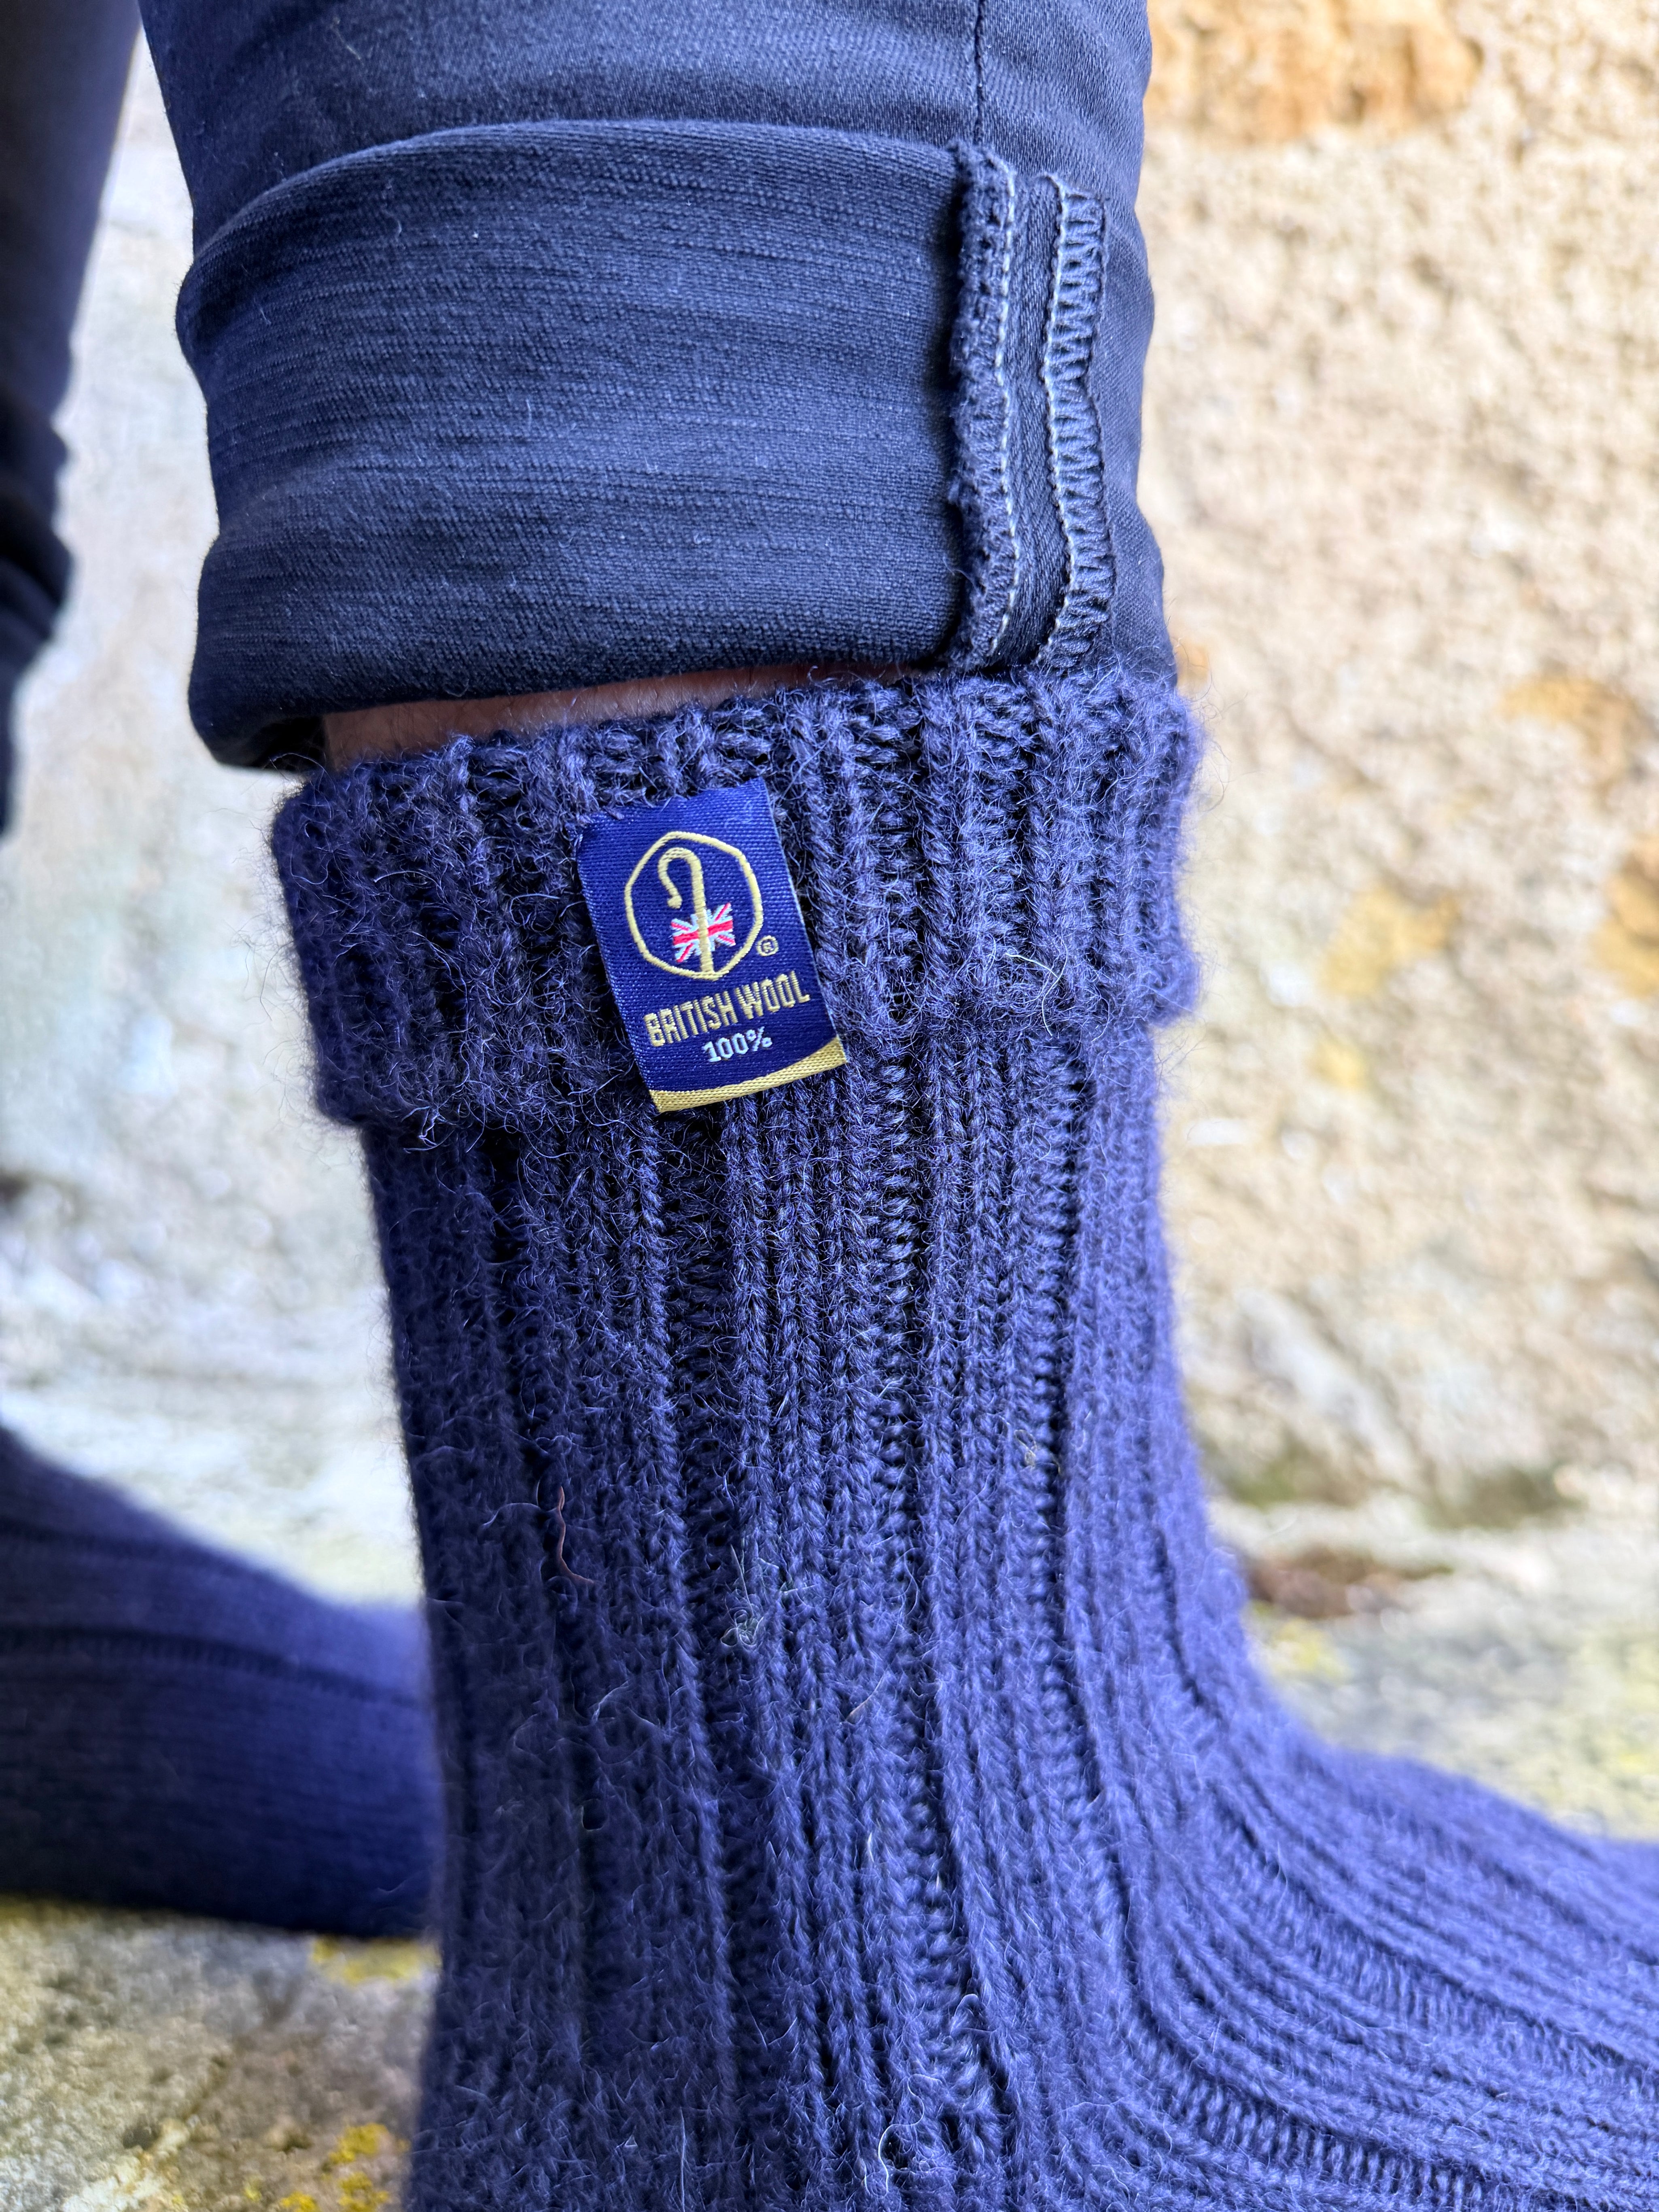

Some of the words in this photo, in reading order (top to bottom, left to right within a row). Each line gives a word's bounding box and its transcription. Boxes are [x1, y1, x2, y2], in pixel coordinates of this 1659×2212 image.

[643, 991, 738, 1047] BRITISH
[734, 971, 811, 1019] WOOL
[702, 1026, 772, 1062] 100%
